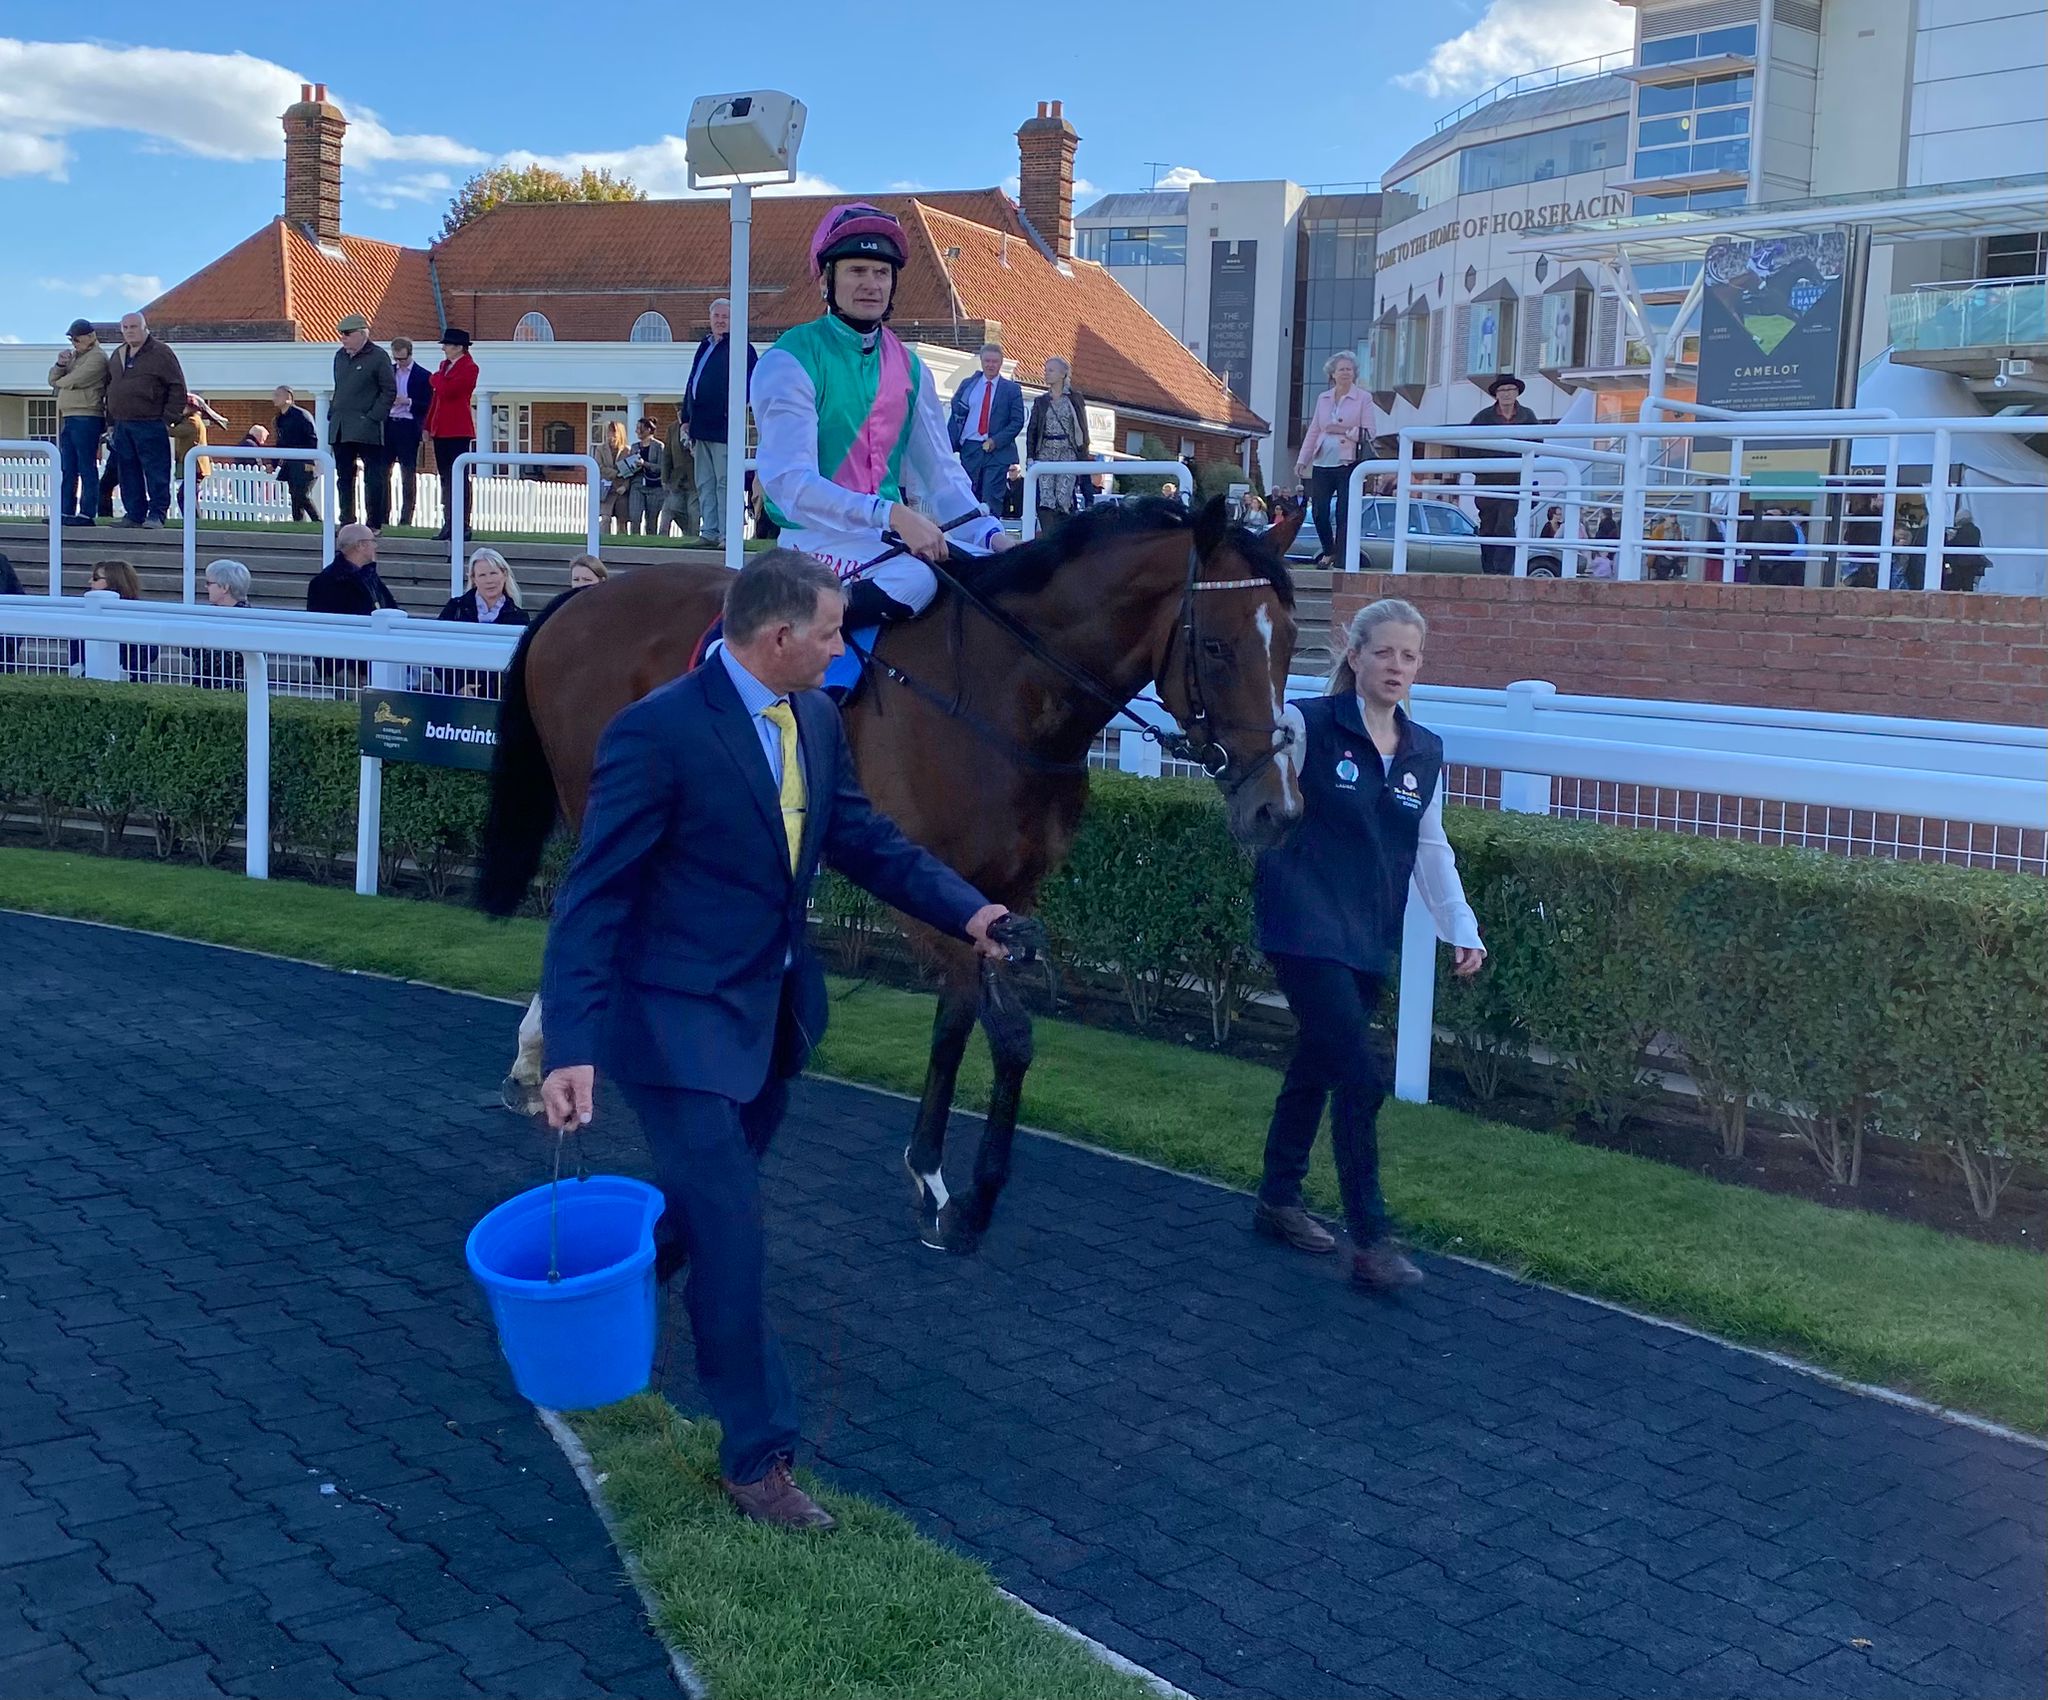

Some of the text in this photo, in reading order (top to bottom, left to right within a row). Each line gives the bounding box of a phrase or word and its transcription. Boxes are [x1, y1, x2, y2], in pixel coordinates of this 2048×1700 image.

[1397, 242, 1409, 263] TO
[1410, 234, 1427, 257] THE
[1428, 221, 1460, 250] HOME
[1463, 216, 1488, 238] OF
[1223, 312, 1240, 320] THE
[1212, 322, 1250, 330] HOME OF
[1734, 364, 1800, 377] CAMELOT
